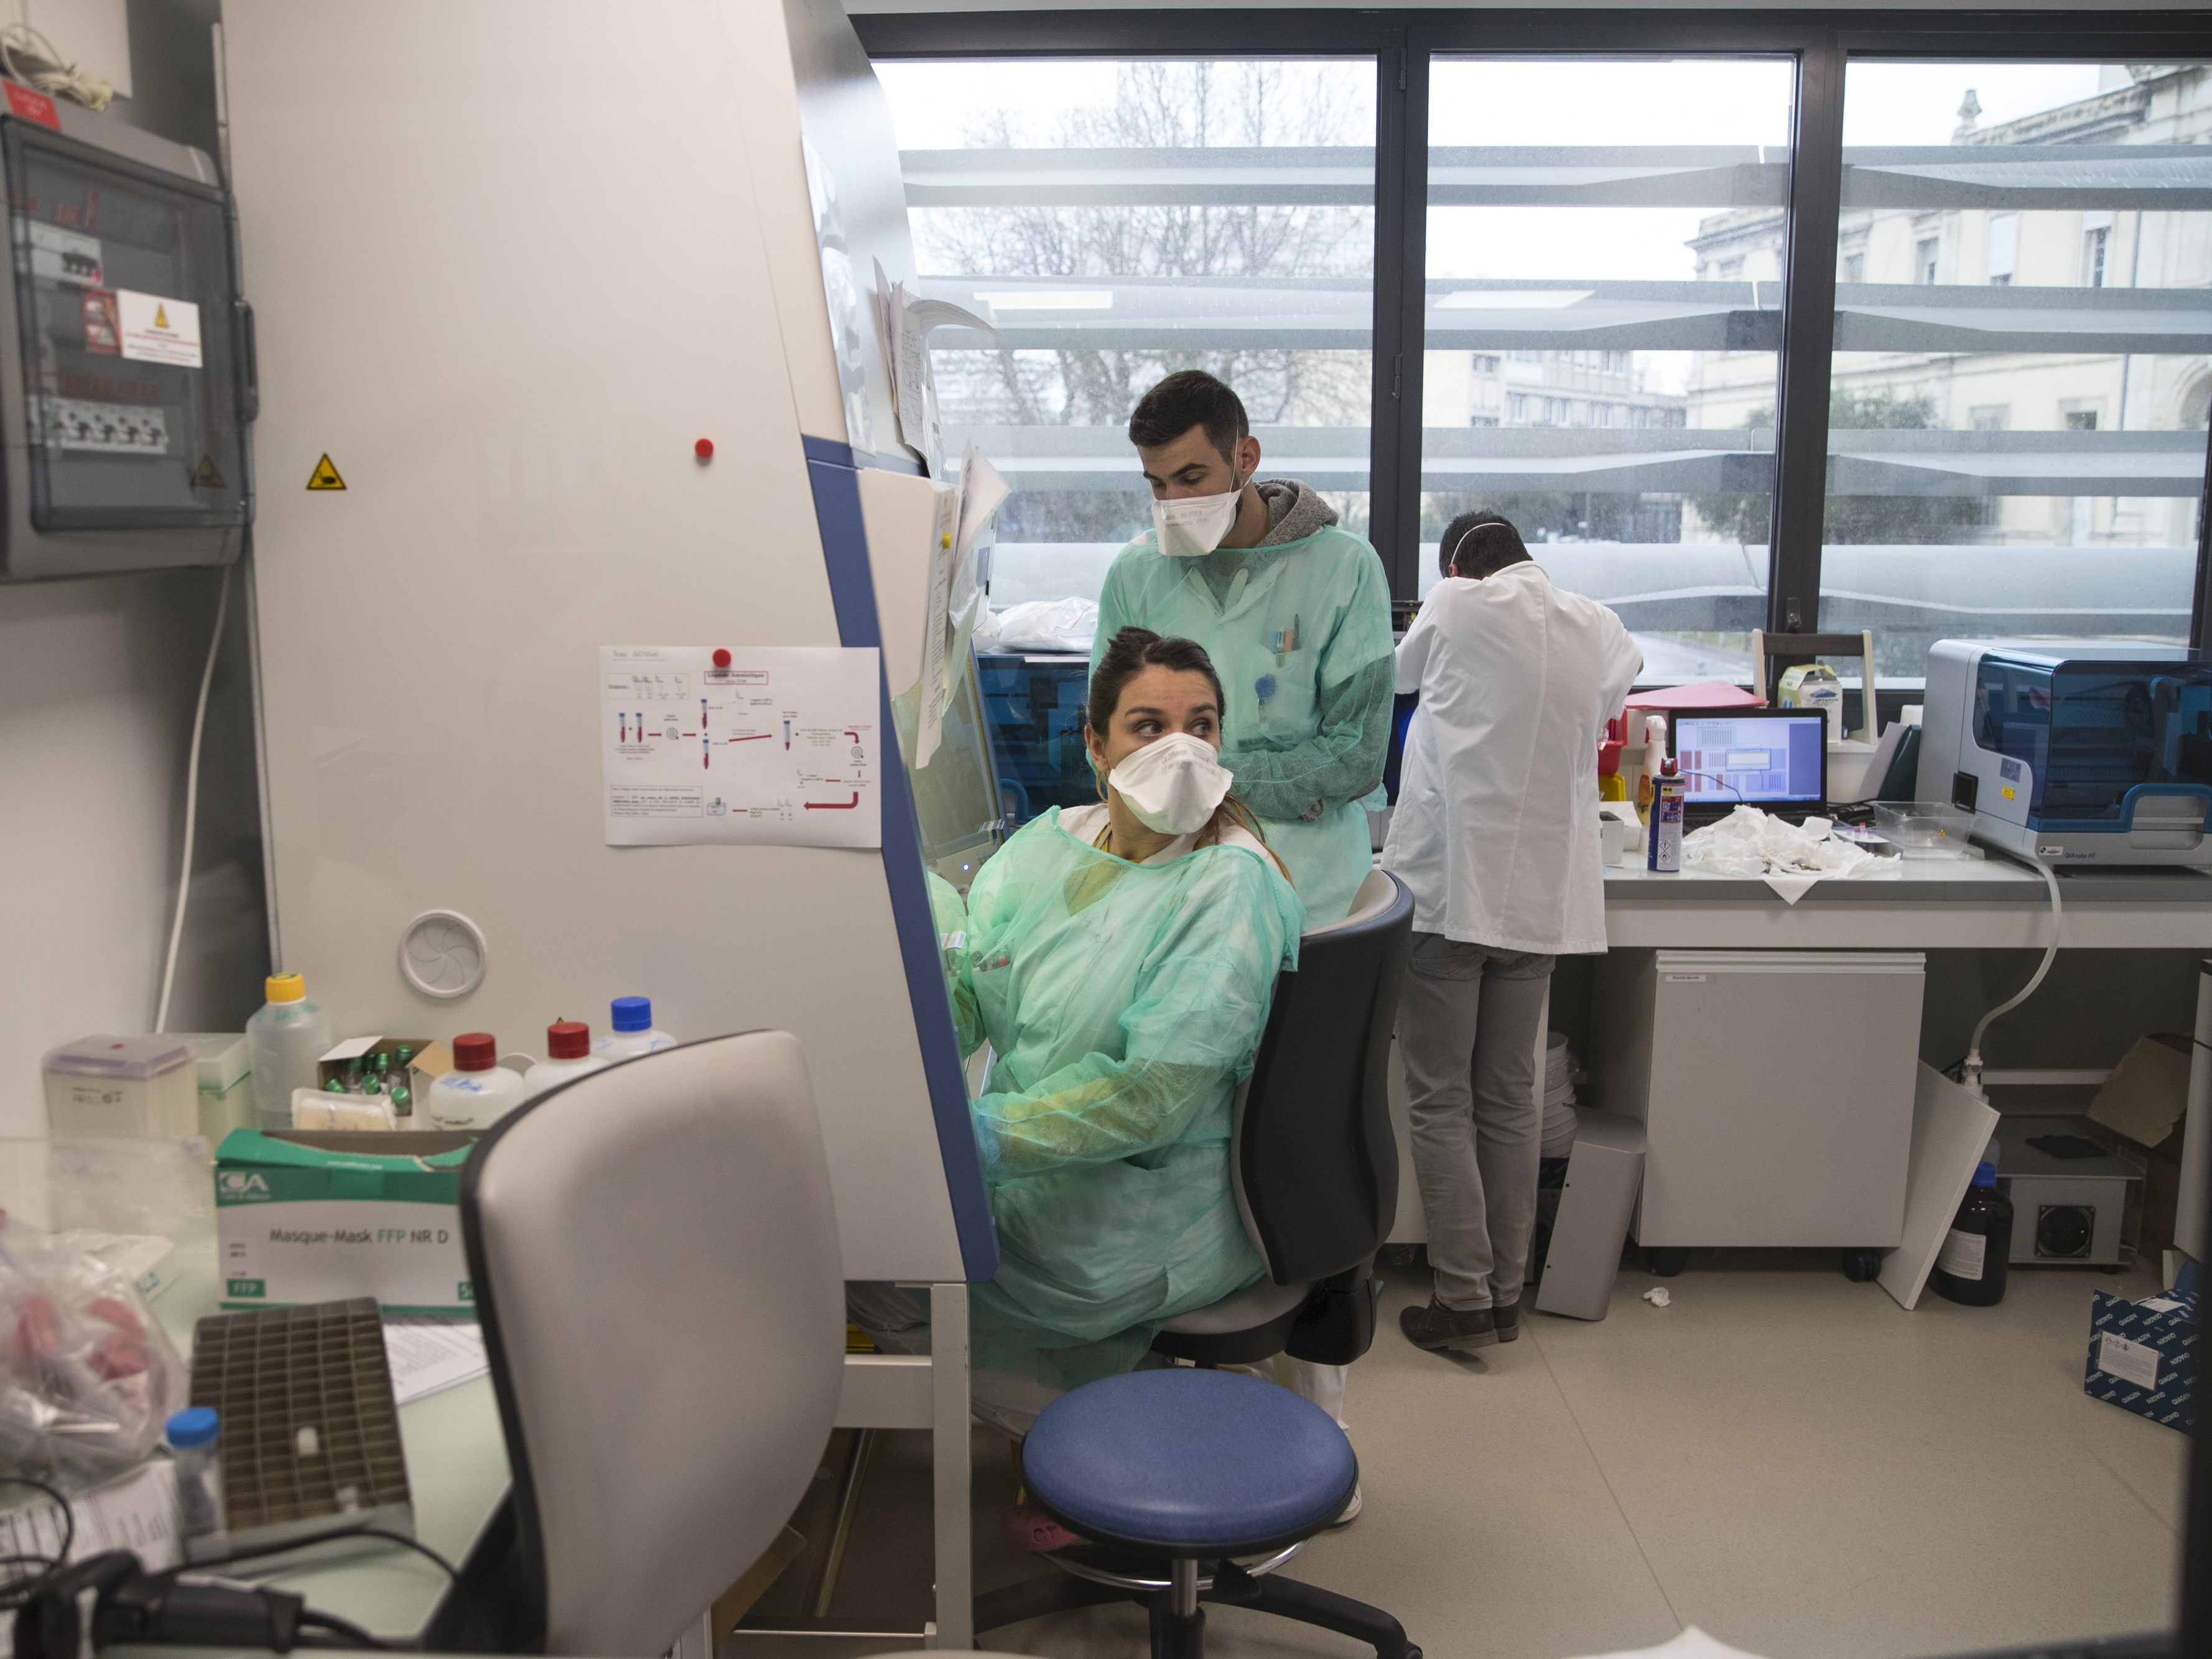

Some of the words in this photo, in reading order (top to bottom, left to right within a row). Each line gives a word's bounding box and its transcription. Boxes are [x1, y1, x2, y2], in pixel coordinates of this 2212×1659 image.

[269, 1228, 373, 1245] Masque-Mask
[377, 1228, 406, 1243] FFP
[410, 1228, 432, 1243] NR
[437, 1228, 449, 1243] D
[2119, 1313, 2138, 1326] QIAGEN
[2142, 1313, 2163, 1327] QIAGEN
[2157, 1332, 2176, 1346] QIAGEN
[2158, 1372, 2178, 1385] QIAGEN
[2121, 1391, 2141, 1404] QIAGEN
[2145, 1392, 2166, 1405] QIAGEN
